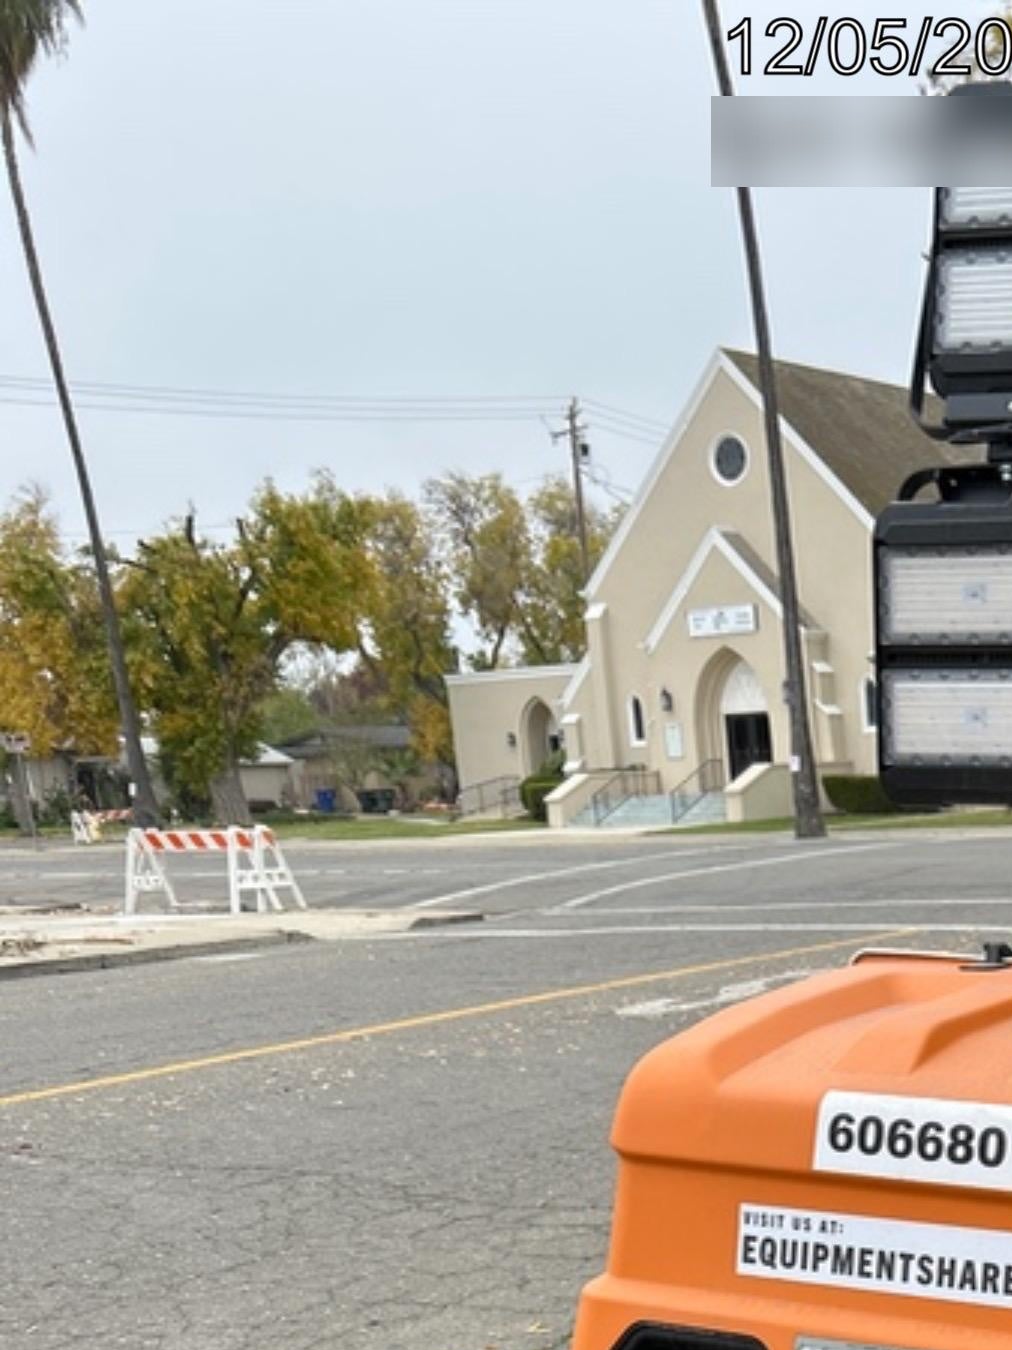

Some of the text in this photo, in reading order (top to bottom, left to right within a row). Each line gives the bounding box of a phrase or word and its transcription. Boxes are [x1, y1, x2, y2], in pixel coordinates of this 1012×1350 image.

[828, 1111, 1007, 1168] 606680
[743, 1211, 844, 1234] VISIT US AT:
